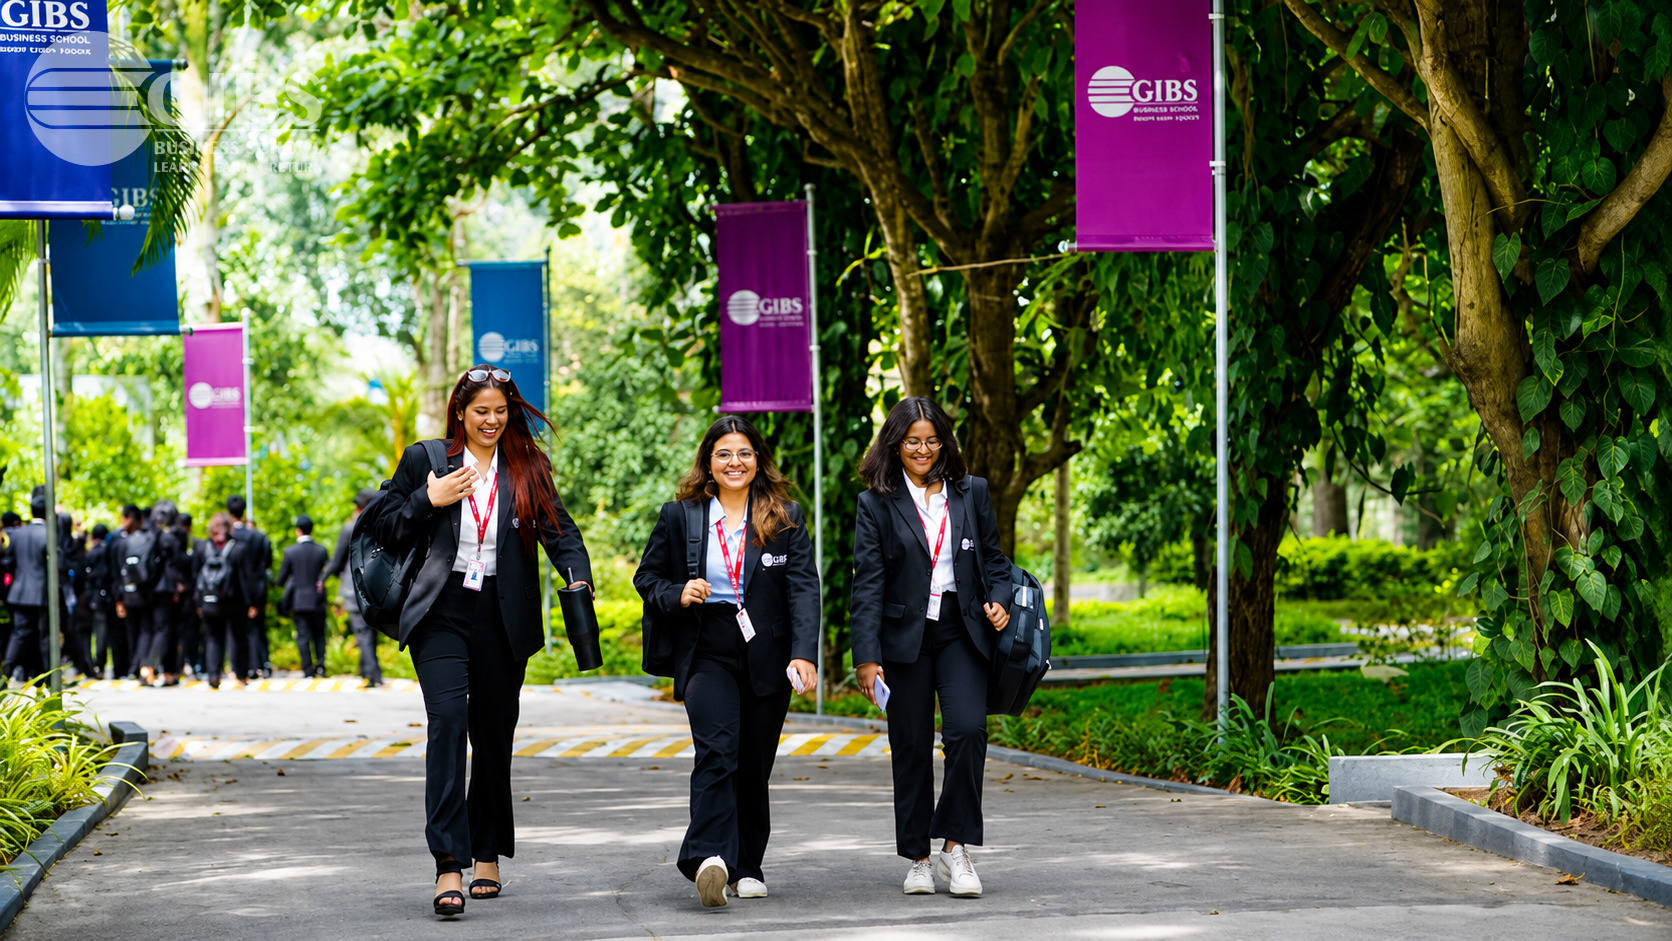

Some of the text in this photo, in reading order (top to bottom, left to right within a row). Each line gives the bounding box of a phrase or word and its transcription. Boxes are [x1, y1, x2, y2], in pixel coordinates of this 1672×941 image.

[1, 0, 90, 29] GIBS
[0, 33, 91, 44] BUSINESS SCHOOL
[1132, 79, 1198, 102] GIBS
[759, 297, 803, 315] GIBS
